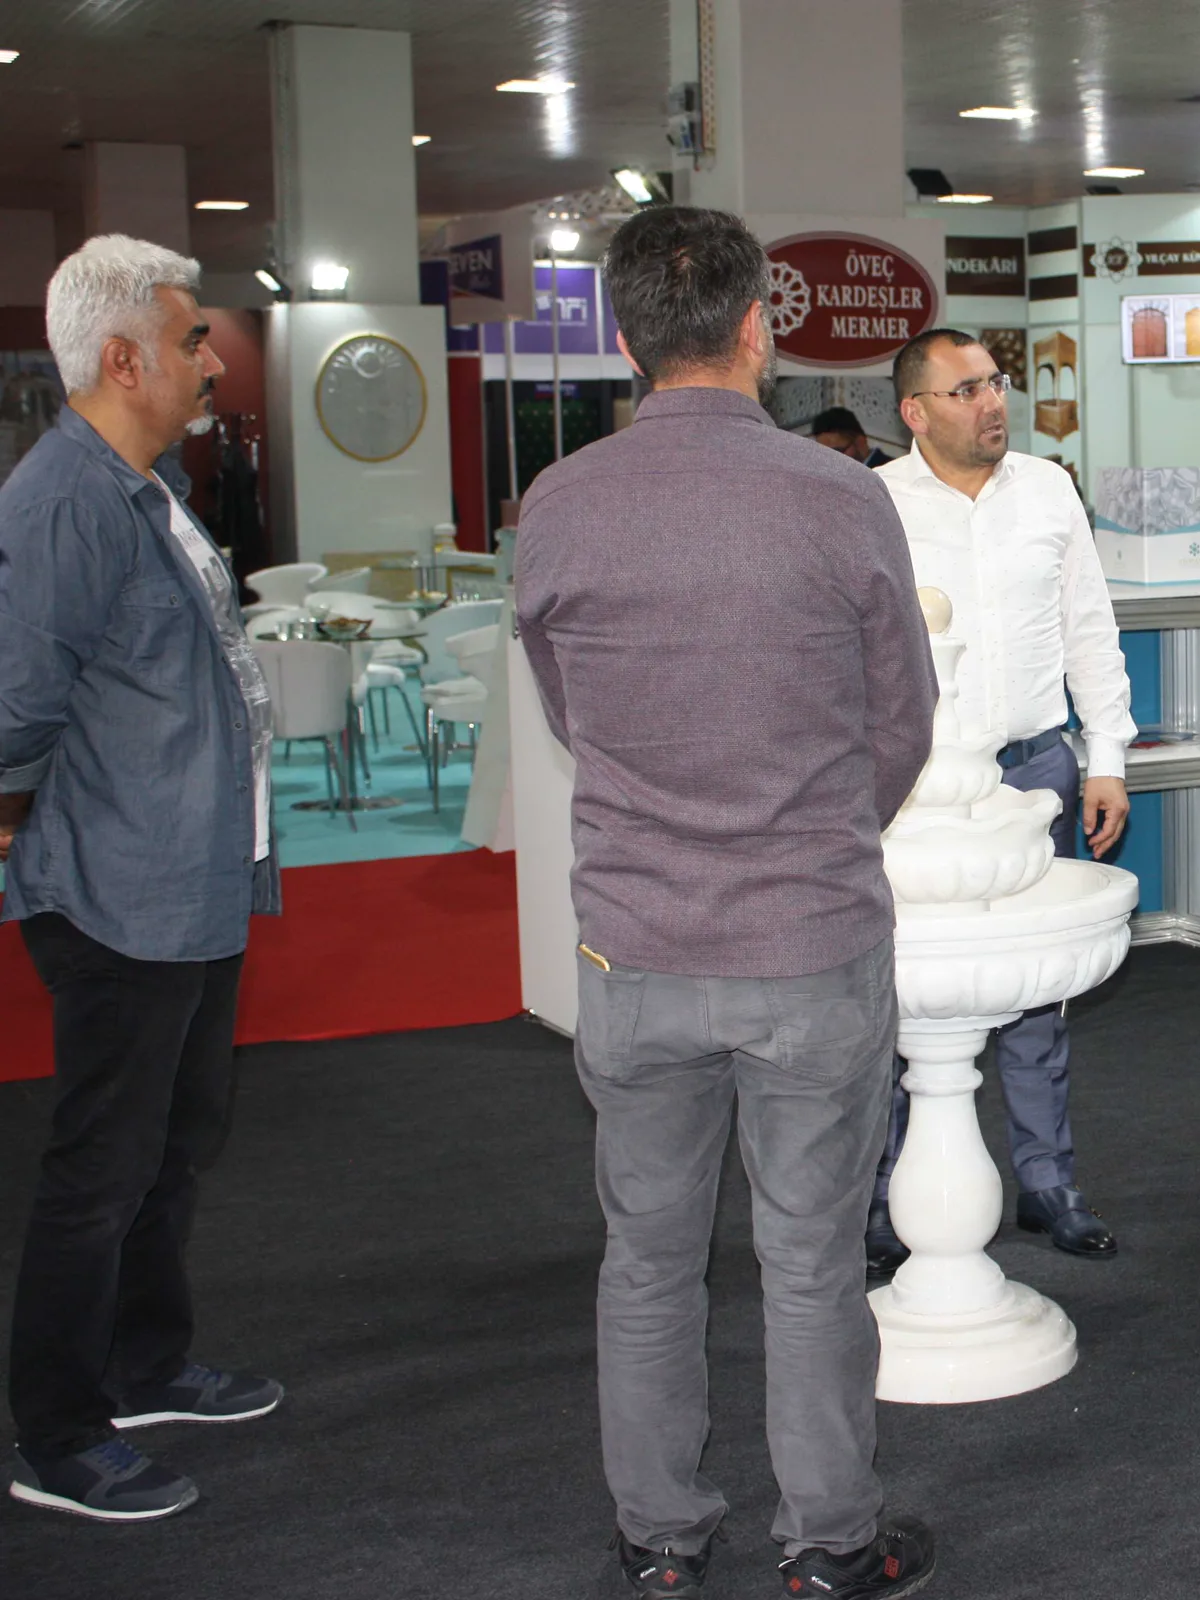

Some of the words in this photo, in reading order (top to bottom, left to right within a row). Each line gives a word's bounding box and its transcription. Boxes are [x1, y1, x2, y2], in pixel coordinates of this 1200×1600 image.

[845, 248, 895, 284] ÖVEÇ
[1144, 252, 1181, 267] YILÇAY
[816, 283, 924, 315] KARDEŞLER
[830, 315, 910, 340] MERMER
